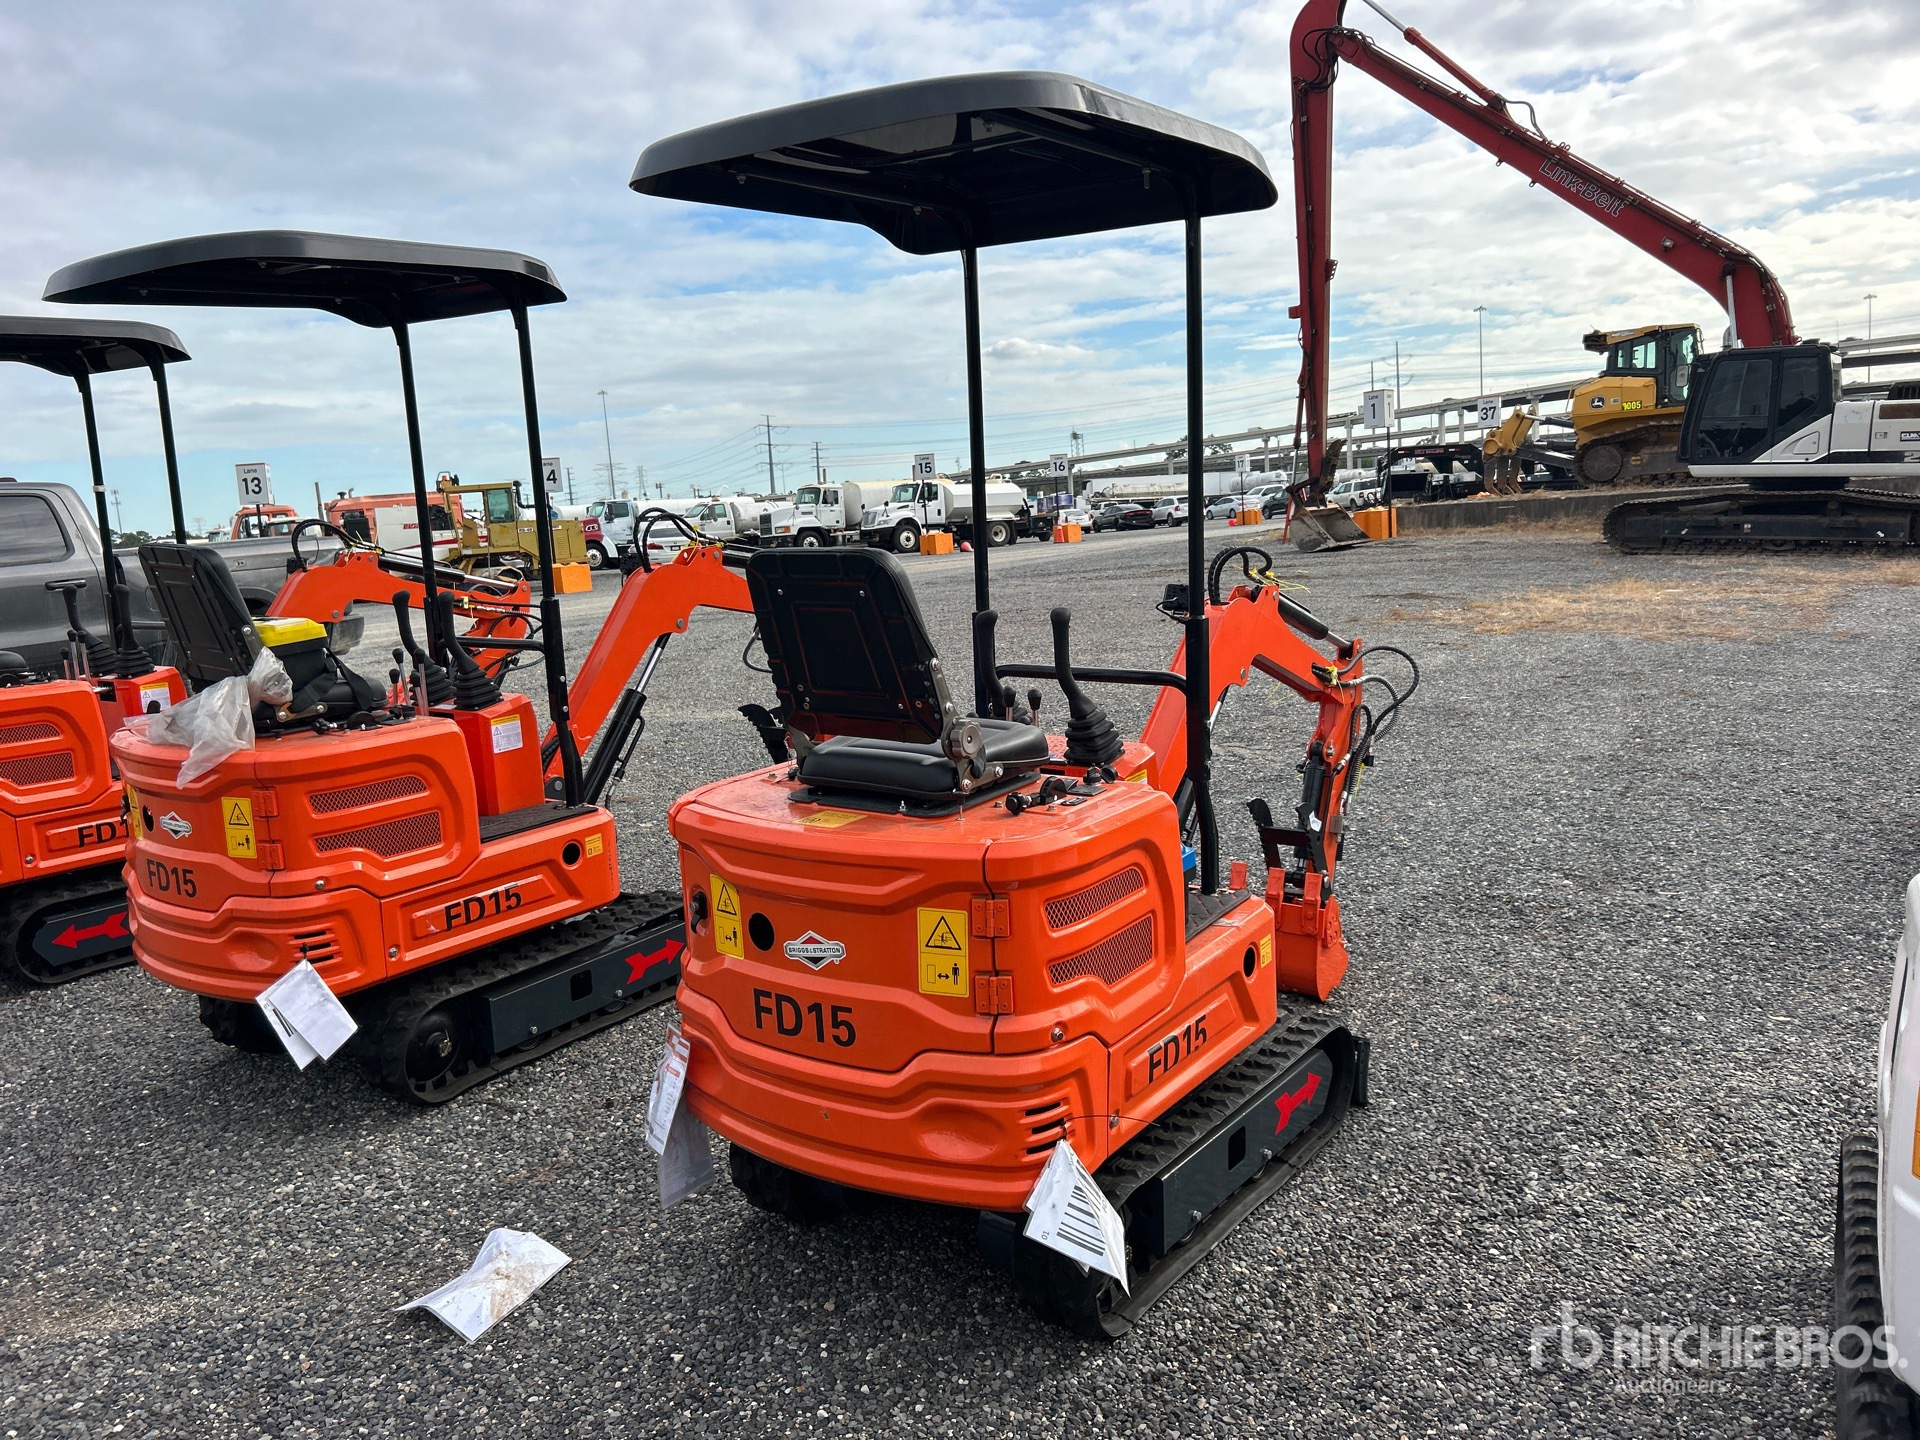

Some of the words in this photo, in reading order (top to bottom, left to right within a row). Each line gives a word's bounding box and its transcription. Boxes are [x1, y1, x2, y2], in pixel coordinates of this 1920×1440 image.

[1538, 158, 1629, 217] Link-Belt
[1370, 402, 1376, 419] 1
[1480, 406, 1497, 420] 37
[918, 461, 933, 474] 15
[1052, 461, 1066, 472] 16
[241, 476, 263, 495] 13
[77, 818, 130, 848] FD1
[146, 858, 198, 898] FD15
[444, 883, 522, 932] FD15
[753, 987, 857, 1048] FD15
[1147, 1013, 1207, 1085] FD15
